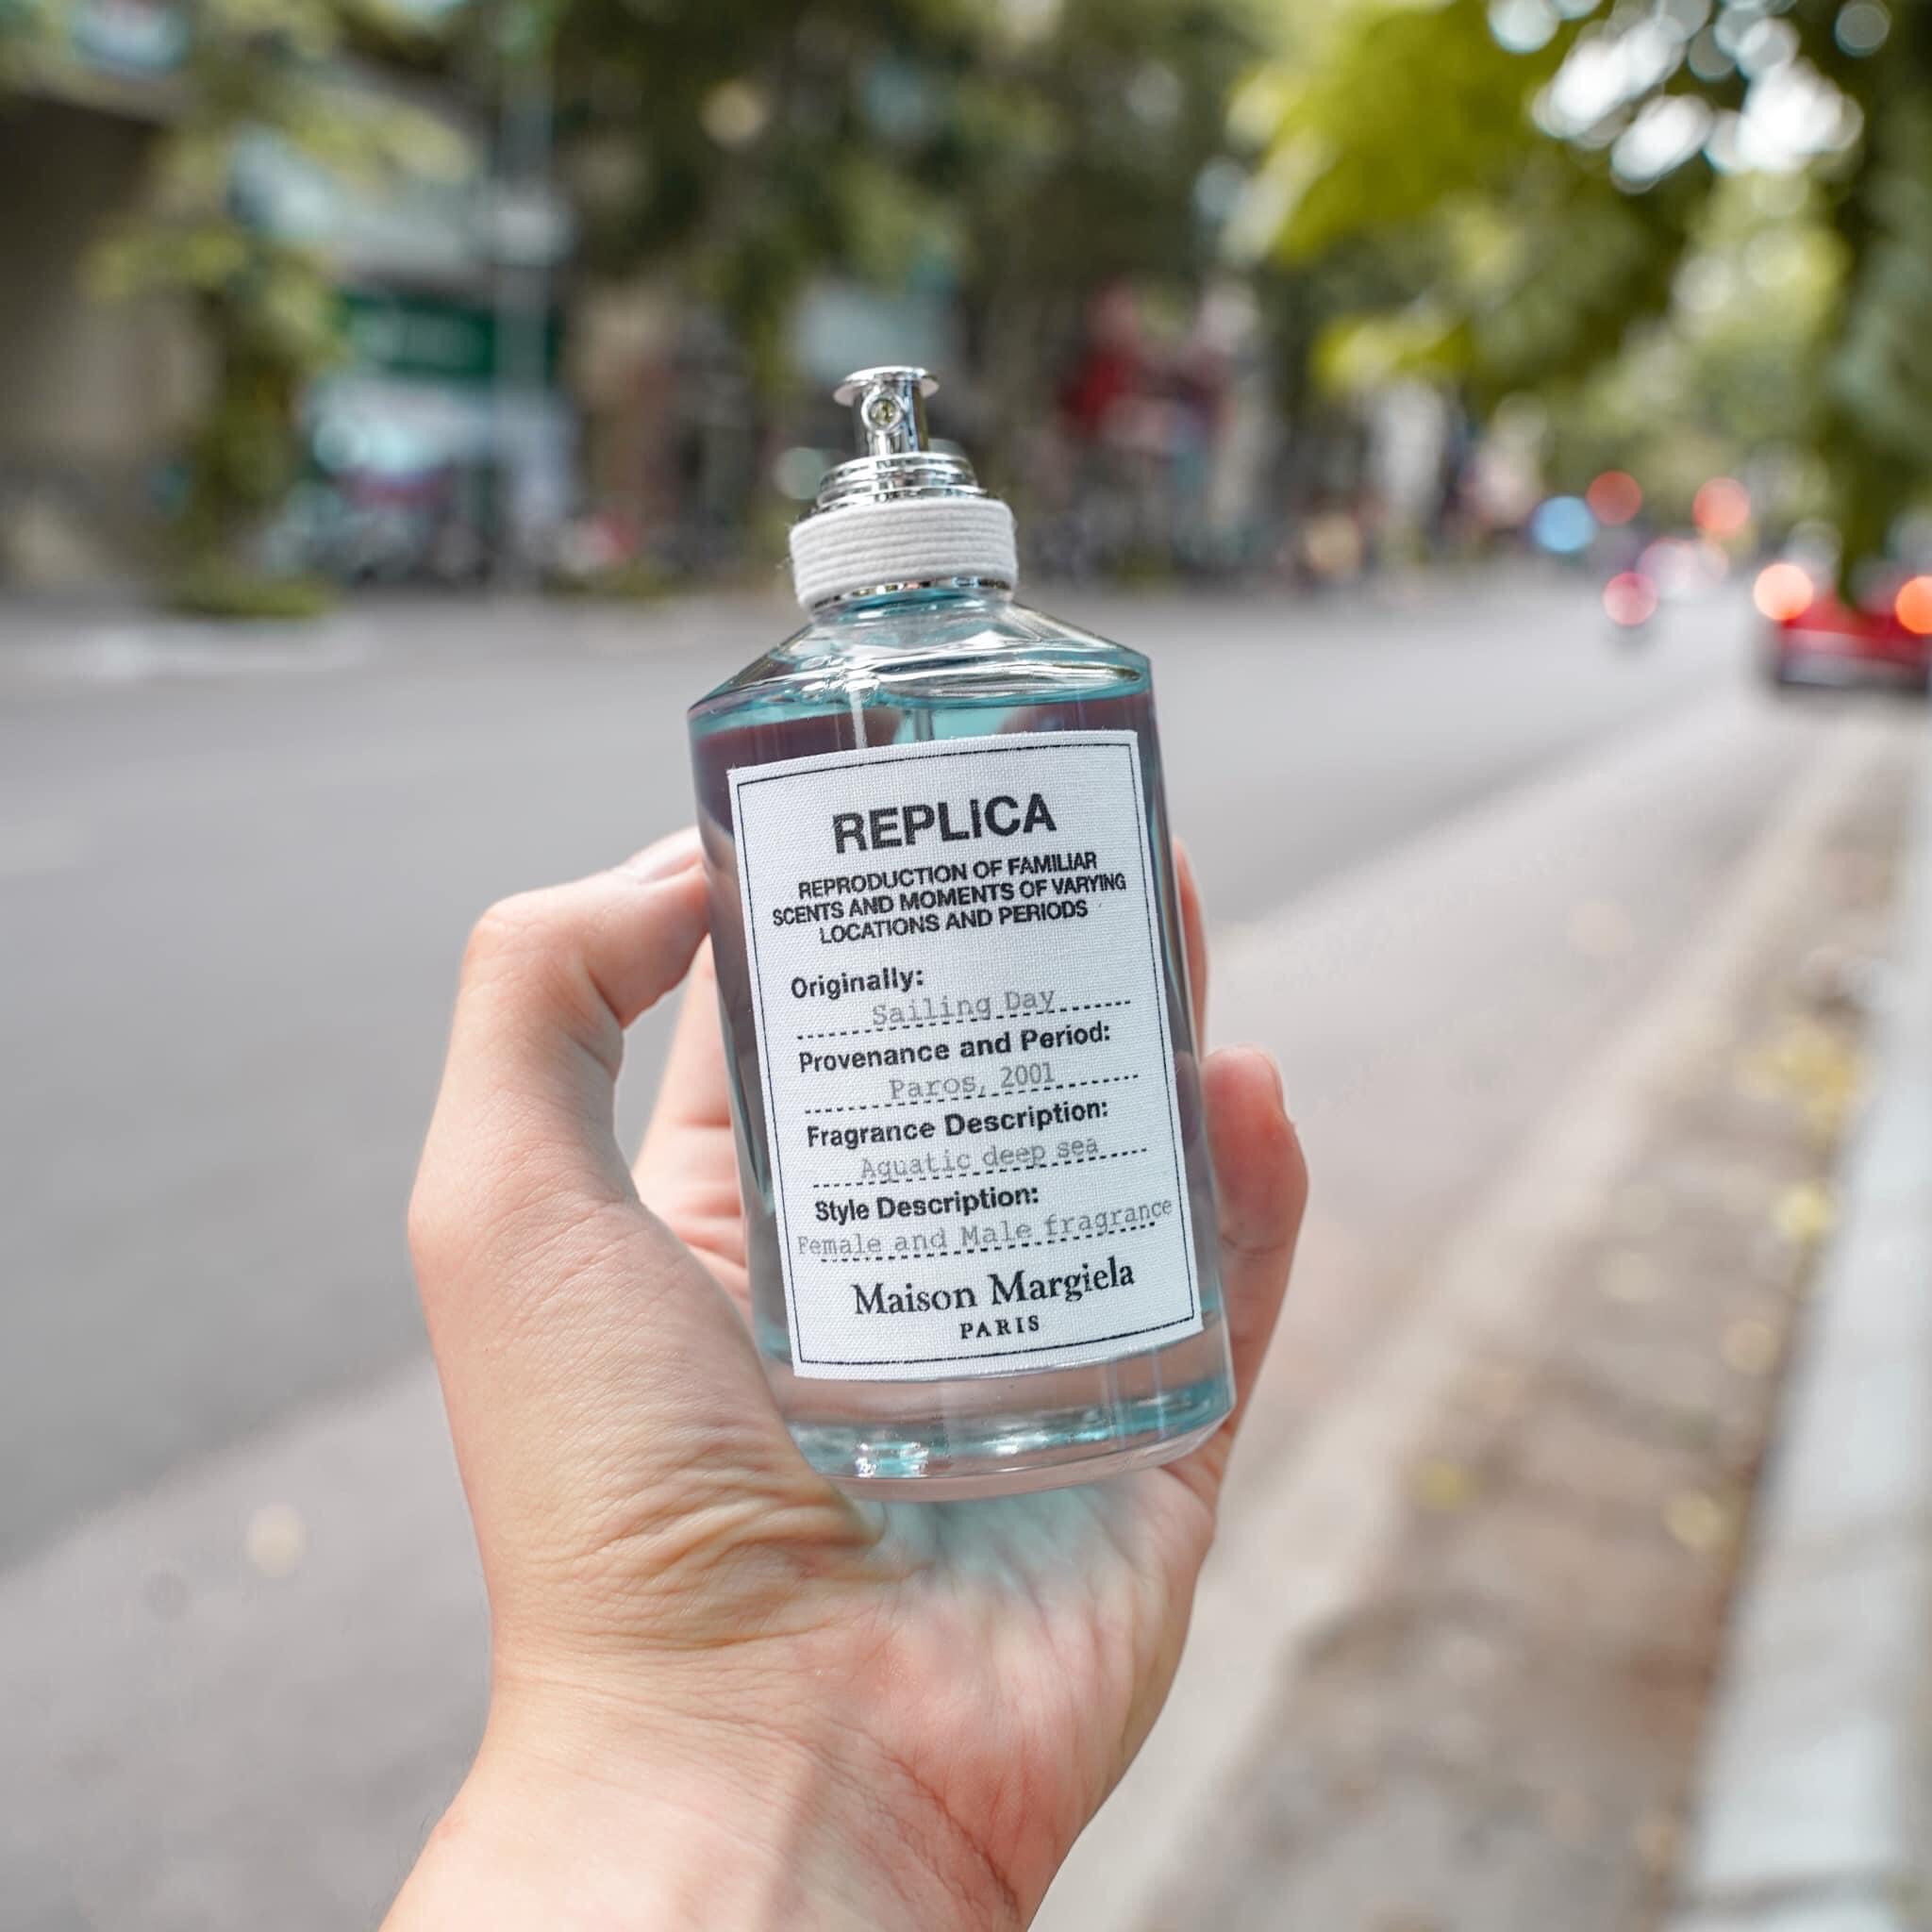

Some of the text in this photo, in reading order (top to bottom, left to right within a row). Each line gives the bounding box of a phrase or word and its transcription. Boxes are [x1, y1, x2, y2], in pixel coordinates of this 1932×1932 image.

[832, 793, 1057, 853] REPLICA
[798, 852, 1097, 899] REPRODUCTION OF FAMILIAR
[773, 873, 1126, 927] SCENTS AND MOMENTS OF VARYING
[820, 899, 1088, 944] LOCATIONS AND PERIODS
[791, 965, 924, 1000] Originally:
[873, 988, 1056, 1025] Sailing Day
[799, 1021, 1110, 1073] Provenance and Period:
[889, 1062, 1055, 1100] Paros, 2001
[808, 1099, 1108, 1149] Fragrance Description:
[861, 1138, 1099, 1183] Aquatic deep sea
[798, 1197, 1172, 1256] Female and Male fragrance
[815, 1185, 1038, 1225] Style Description:
[853, 1256, 1134, 1315] Maison Margiela
[960, 1315, 1041, 1339] PARIS
